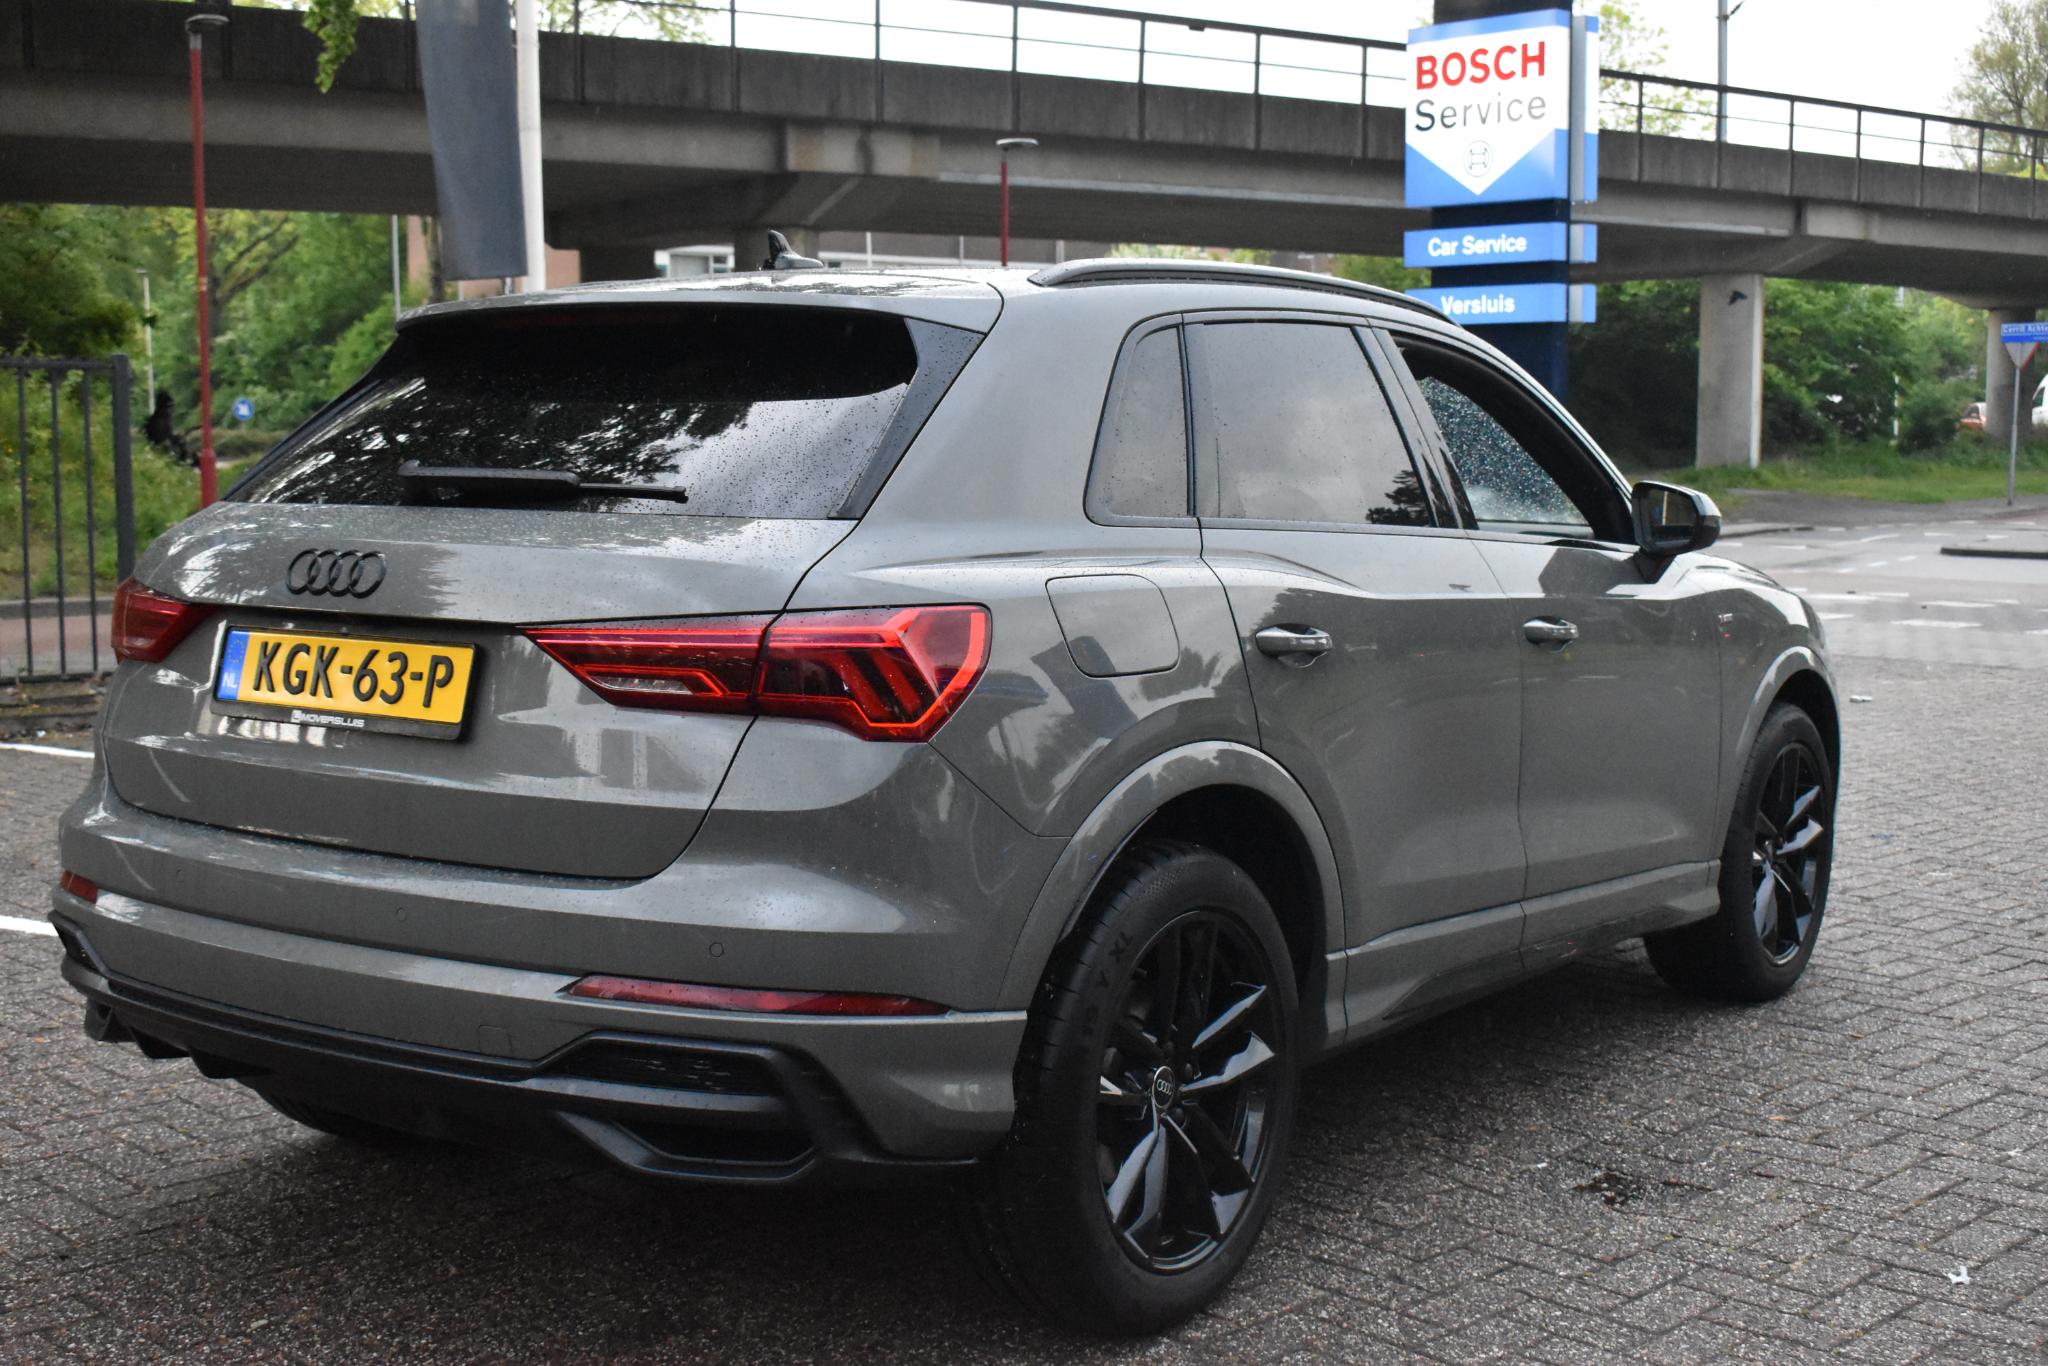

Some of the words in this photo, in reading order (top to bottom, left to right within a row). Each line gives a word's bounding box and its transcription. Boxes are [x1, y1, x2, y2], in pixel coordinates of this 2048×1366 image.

[1416, 41, 1545, 90] BOSCH
[1415, 92, 1546, 131] Service
[1427, 237, 1458, 256] Car
[1461, 234, 1527, 255] Service
[1440, 293, 1515, 315] Versluis
[222, 673, 237, 688] NL
[252, 641, 454, 708] KGK-63-P
